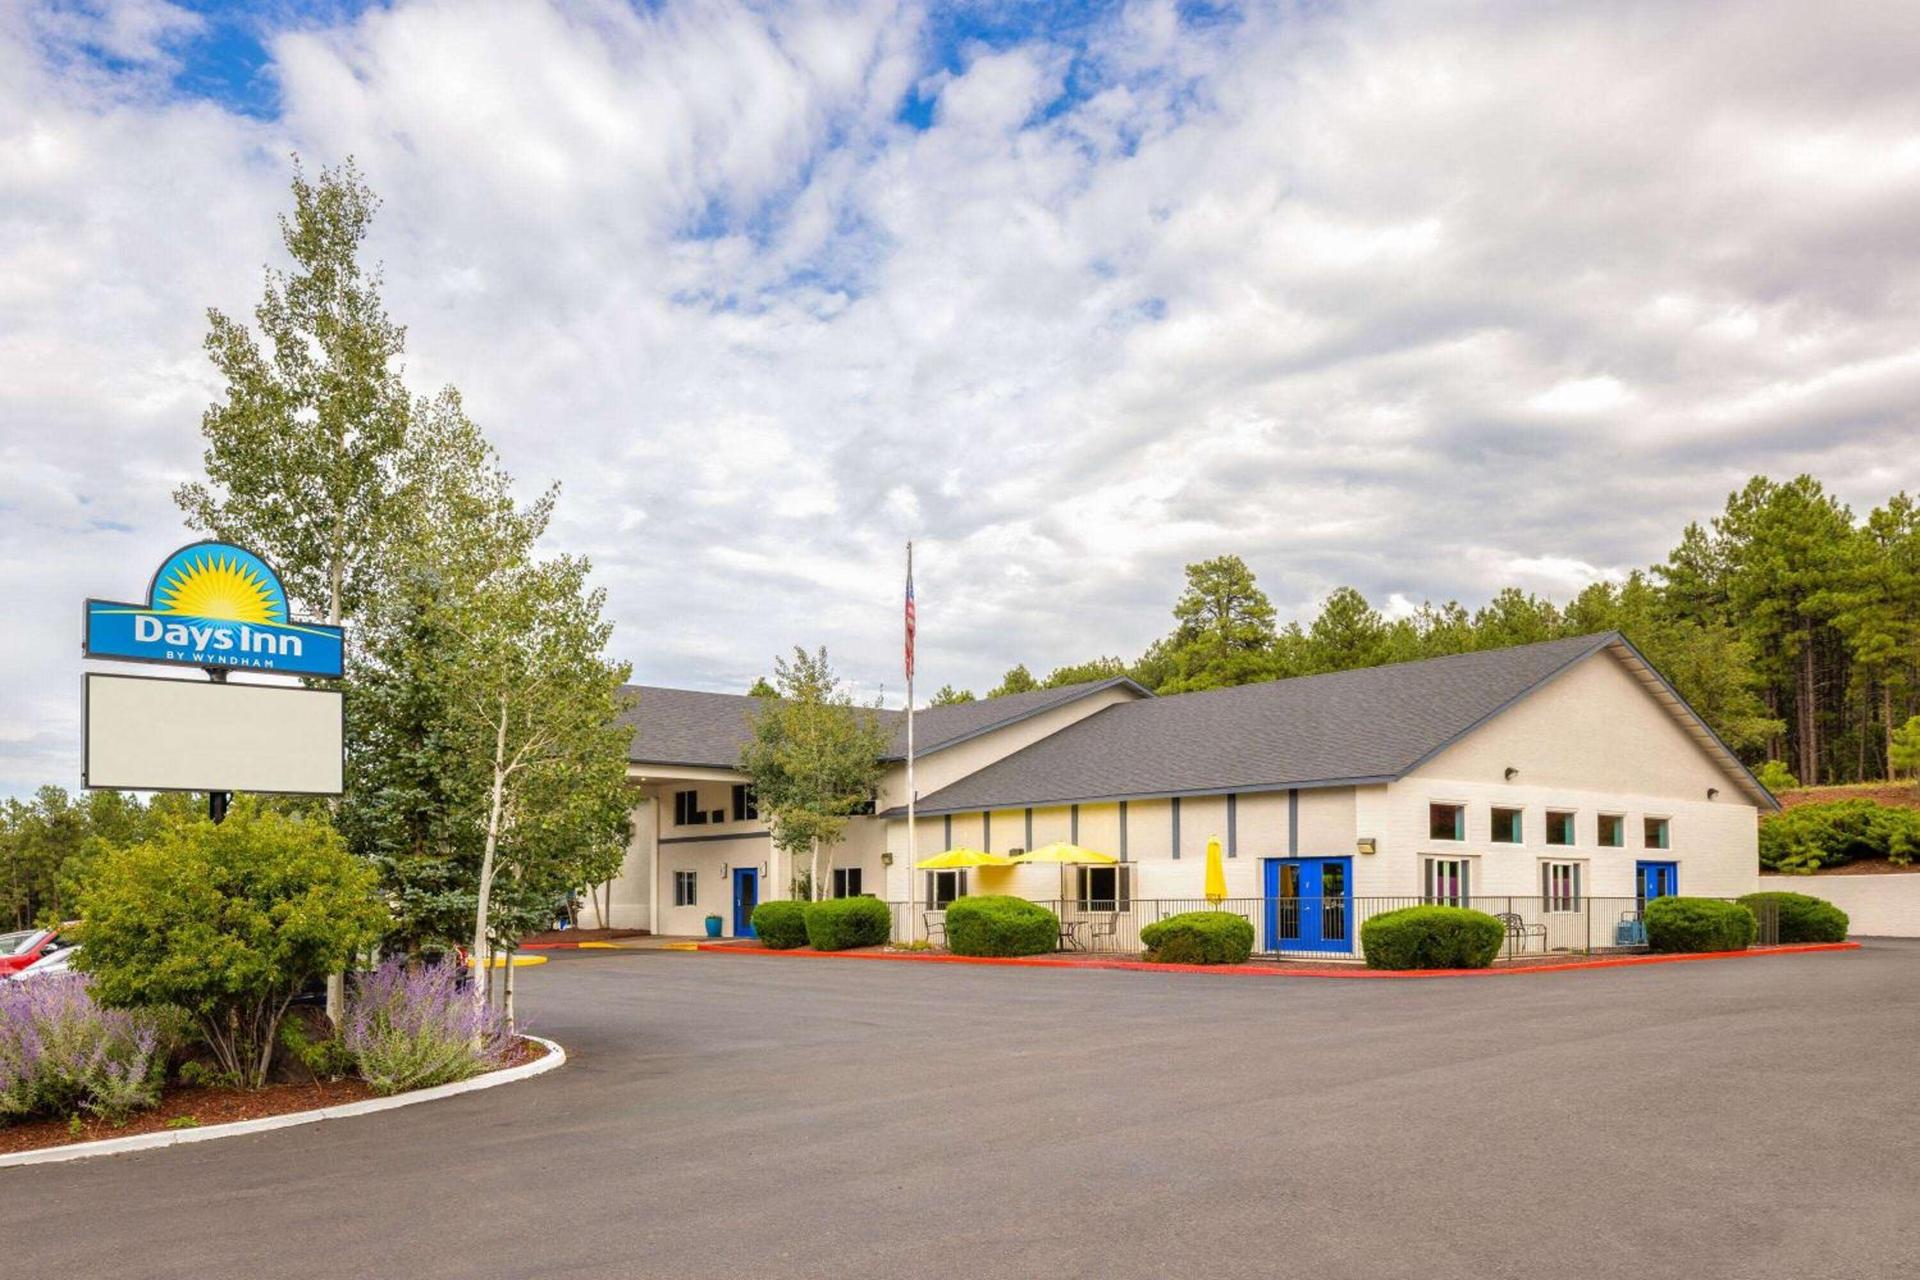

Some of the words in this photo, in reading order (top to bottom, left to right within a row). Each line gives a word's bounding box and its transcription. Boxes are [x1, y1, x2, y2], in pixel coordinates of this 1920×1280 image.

[135, 615, 234, 651] Days
[241, 625, 303, 657] Inn
[166, 650, 185, 660] BY
[192, 652, 275, 668] WYNDHAM
